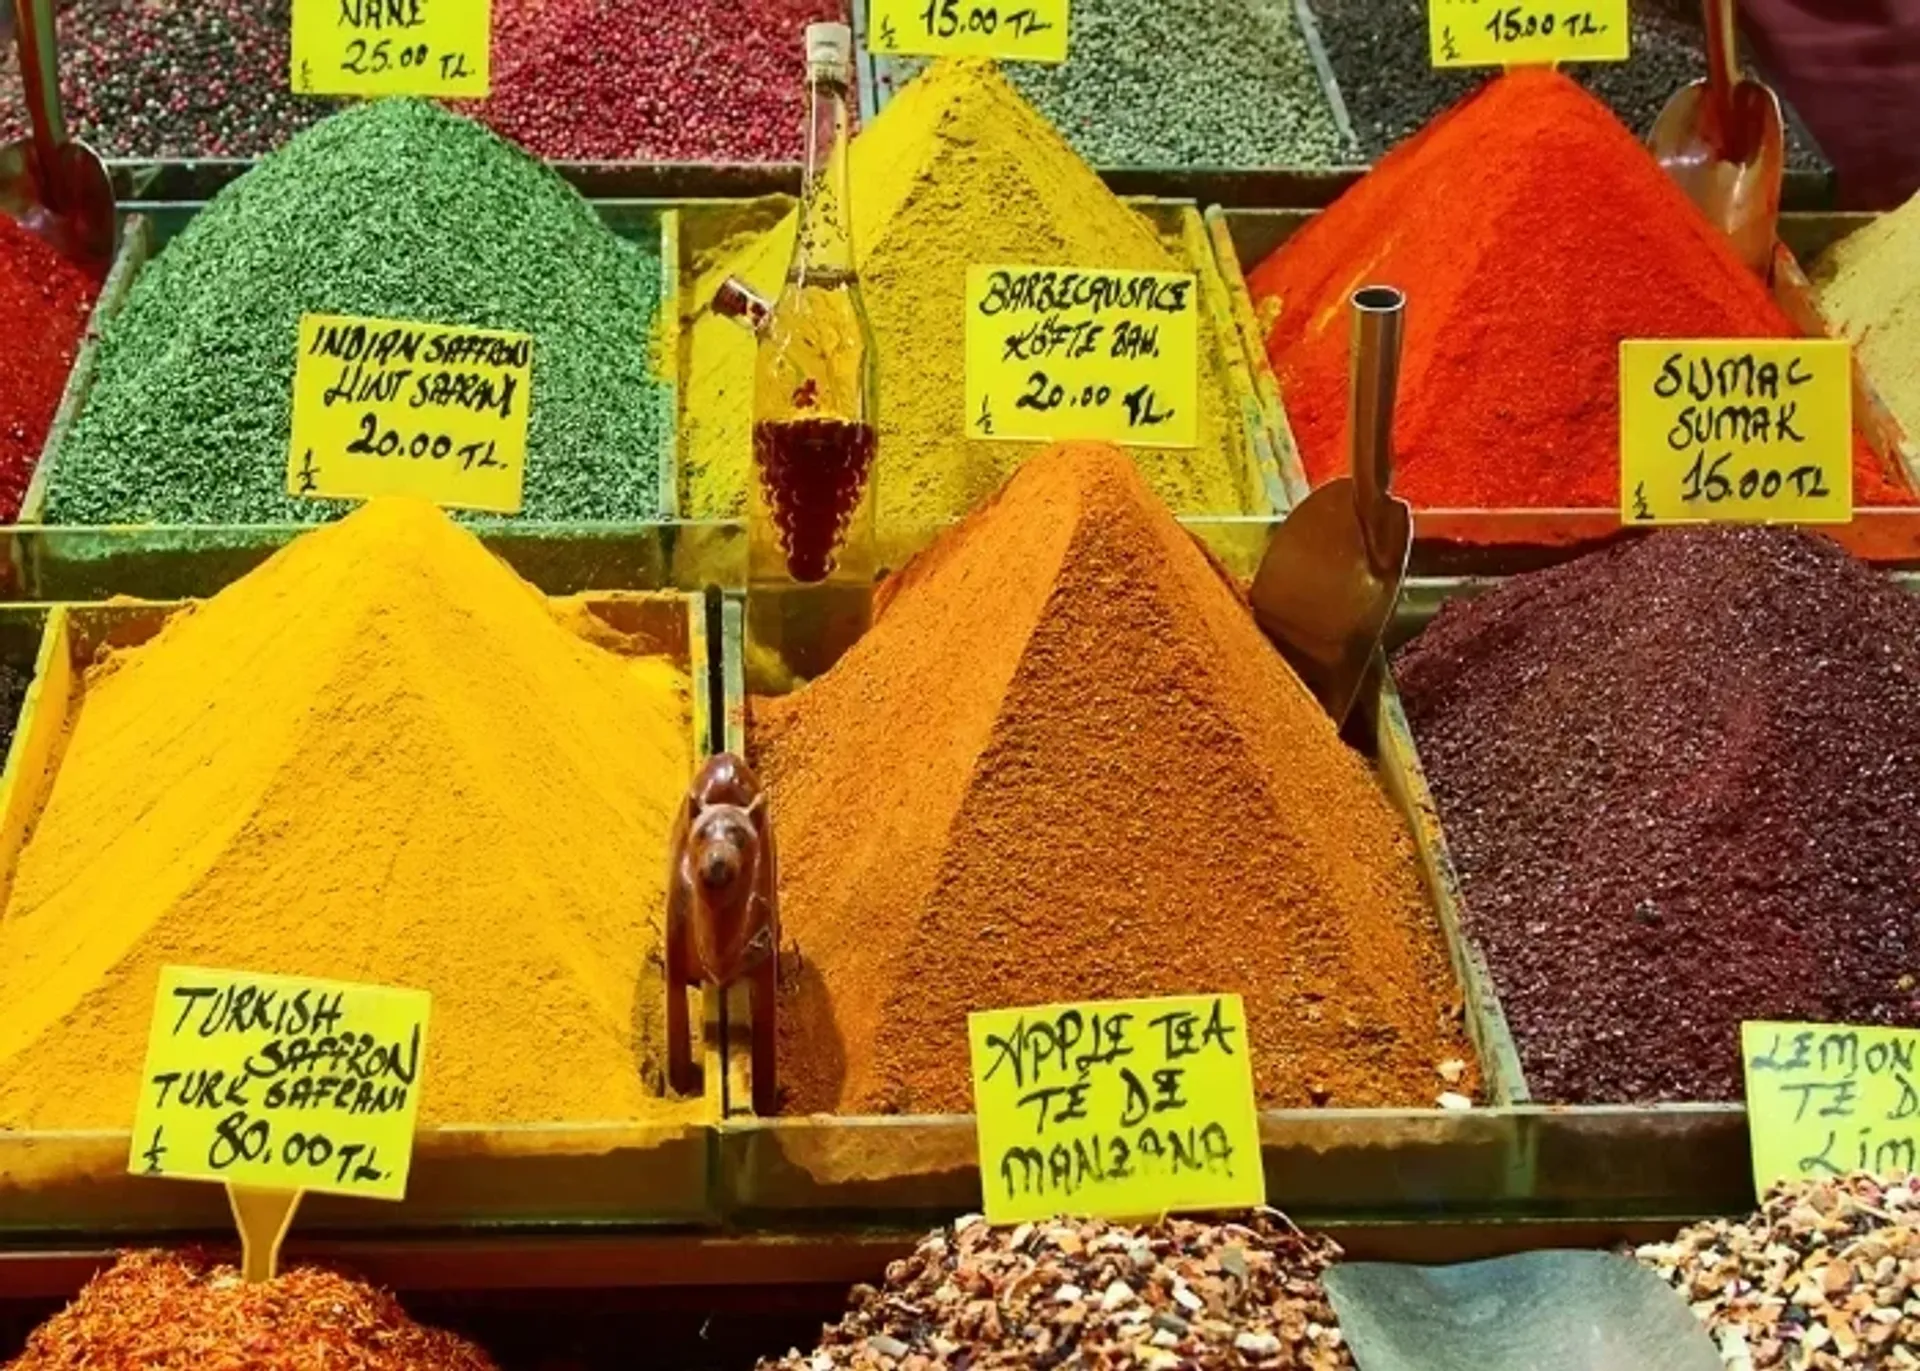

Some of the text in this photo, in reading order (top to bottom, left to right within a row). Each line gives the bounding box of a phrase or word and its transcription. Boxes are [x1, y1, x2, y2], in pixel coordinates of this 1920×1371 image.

[309, 325, 424, 366] INDIAN
[1654, 353, 1814, 401] SUMAC
[346, 412, 452, 459] 20.00
[1668, 401, 1805, 450] SUMAK
[173, 984, 343, 1037] TURKISH
[244, 1022, 420, 1085] SAFFRON
[983, 999, 1236, 1088] APPLE TEA
[1751, 1031, 1916, 1075] LEMON
[1120, 1067, 1187, 1128] DE
[209, 1111, 333, 1169] 80.00
[1001, 1122, 1234, 1200] MANZANA
